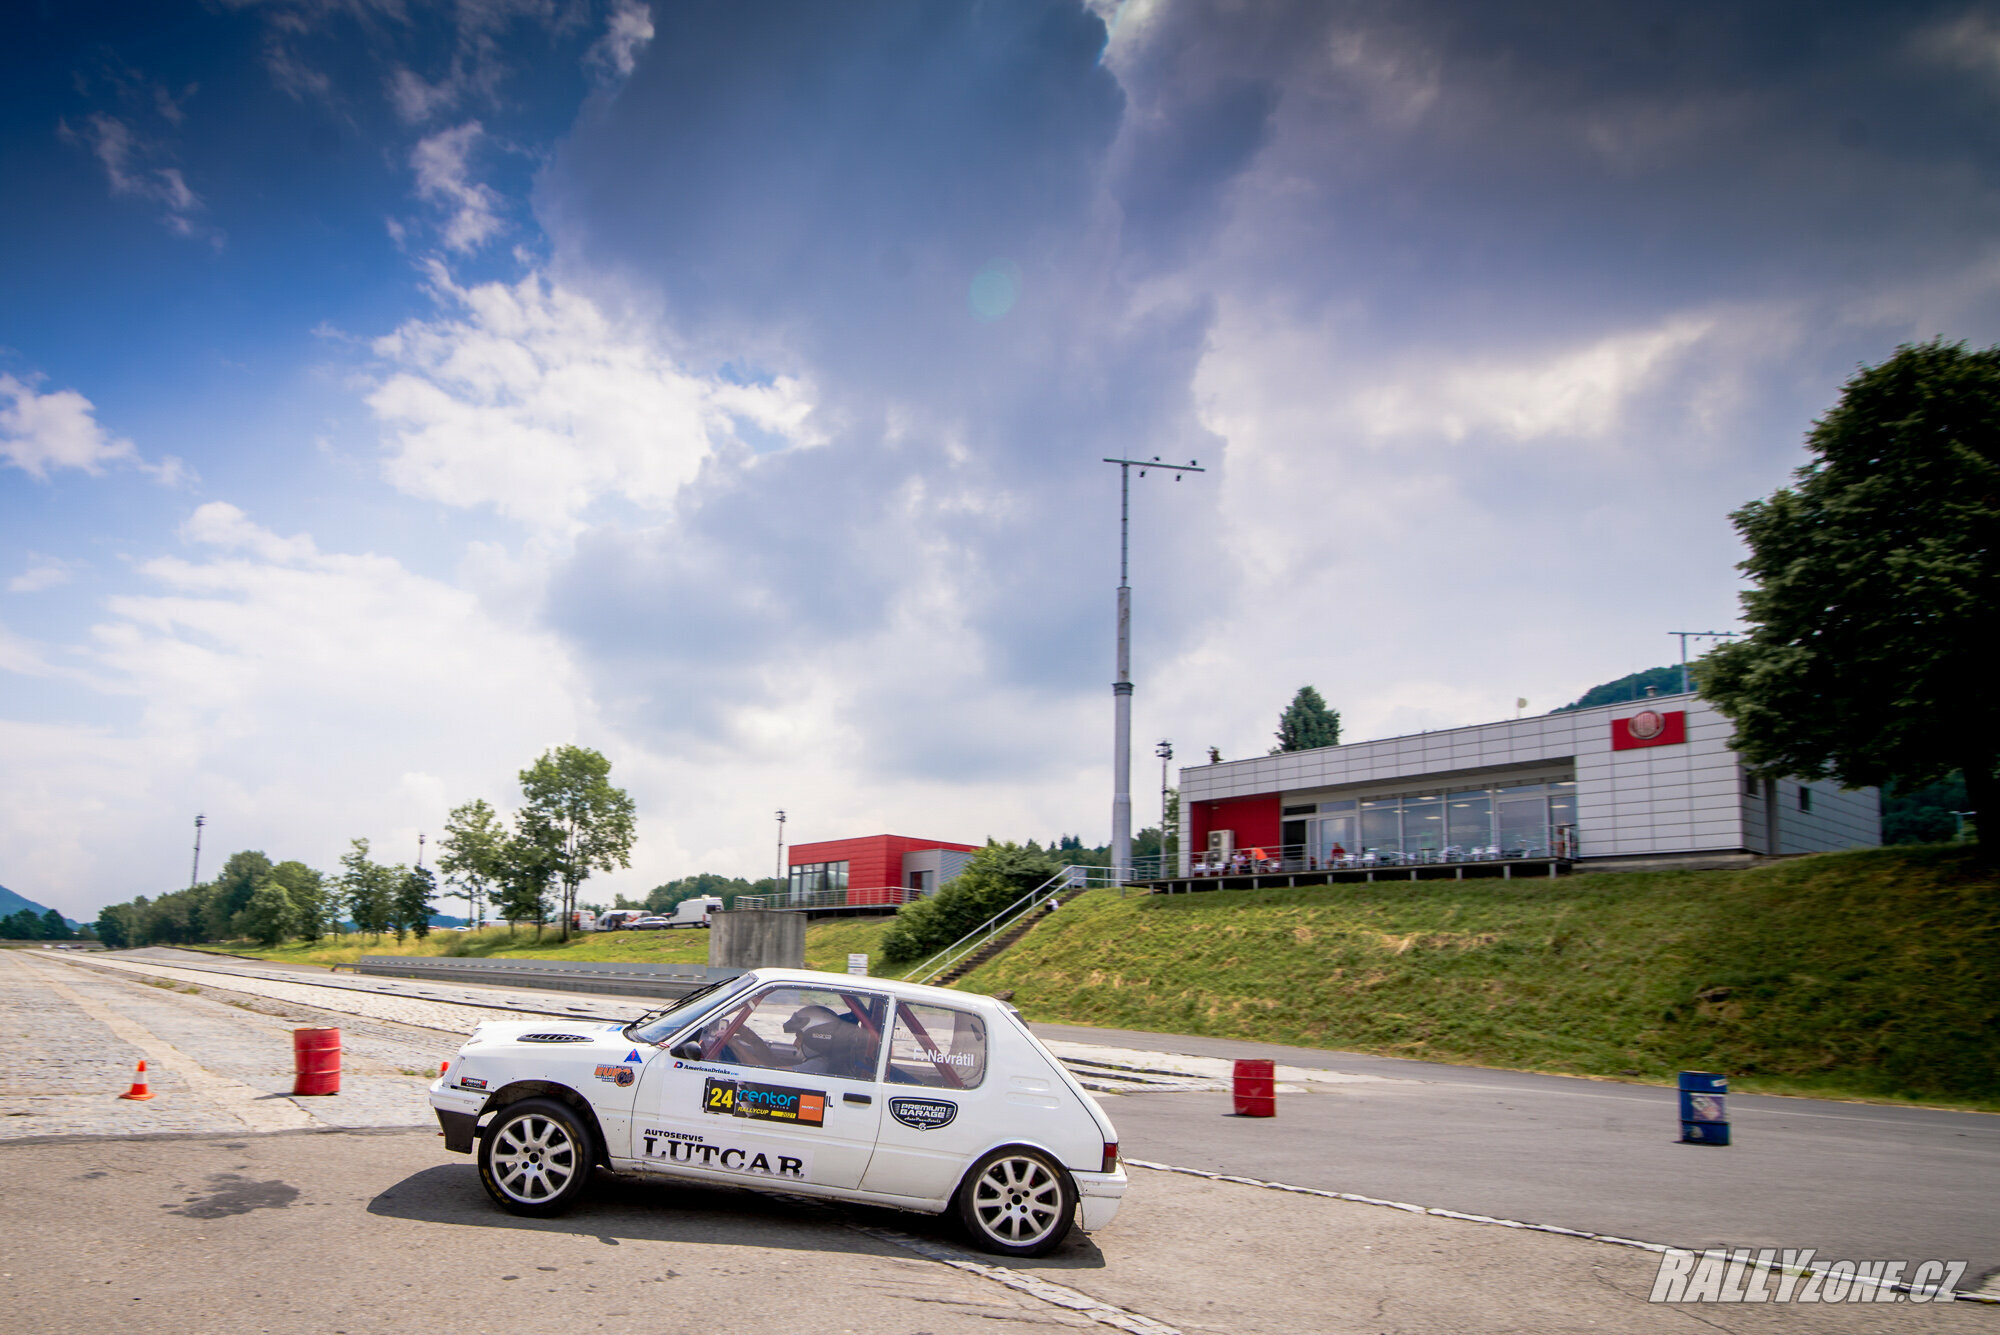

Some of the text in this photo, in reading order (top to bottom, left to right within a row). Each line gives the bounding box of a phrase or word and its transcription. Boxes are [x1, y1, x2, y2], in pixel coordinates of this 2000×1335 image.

[928, 1049, 975, 1066] Navrátil
[709, 1087, 734, 1108] 24
[738, 1089, 797, 1107] rentor
[737, 1106, 769, 1115] RALLYCUP
[900, 1109, 945, 1118] GARAGE
[901, 1103, 946, 1112] PREMIUM
[644, 1128, 704, 1142] AUTOSERVIS
[641, 1136, 805, 1180] LUTCAR
